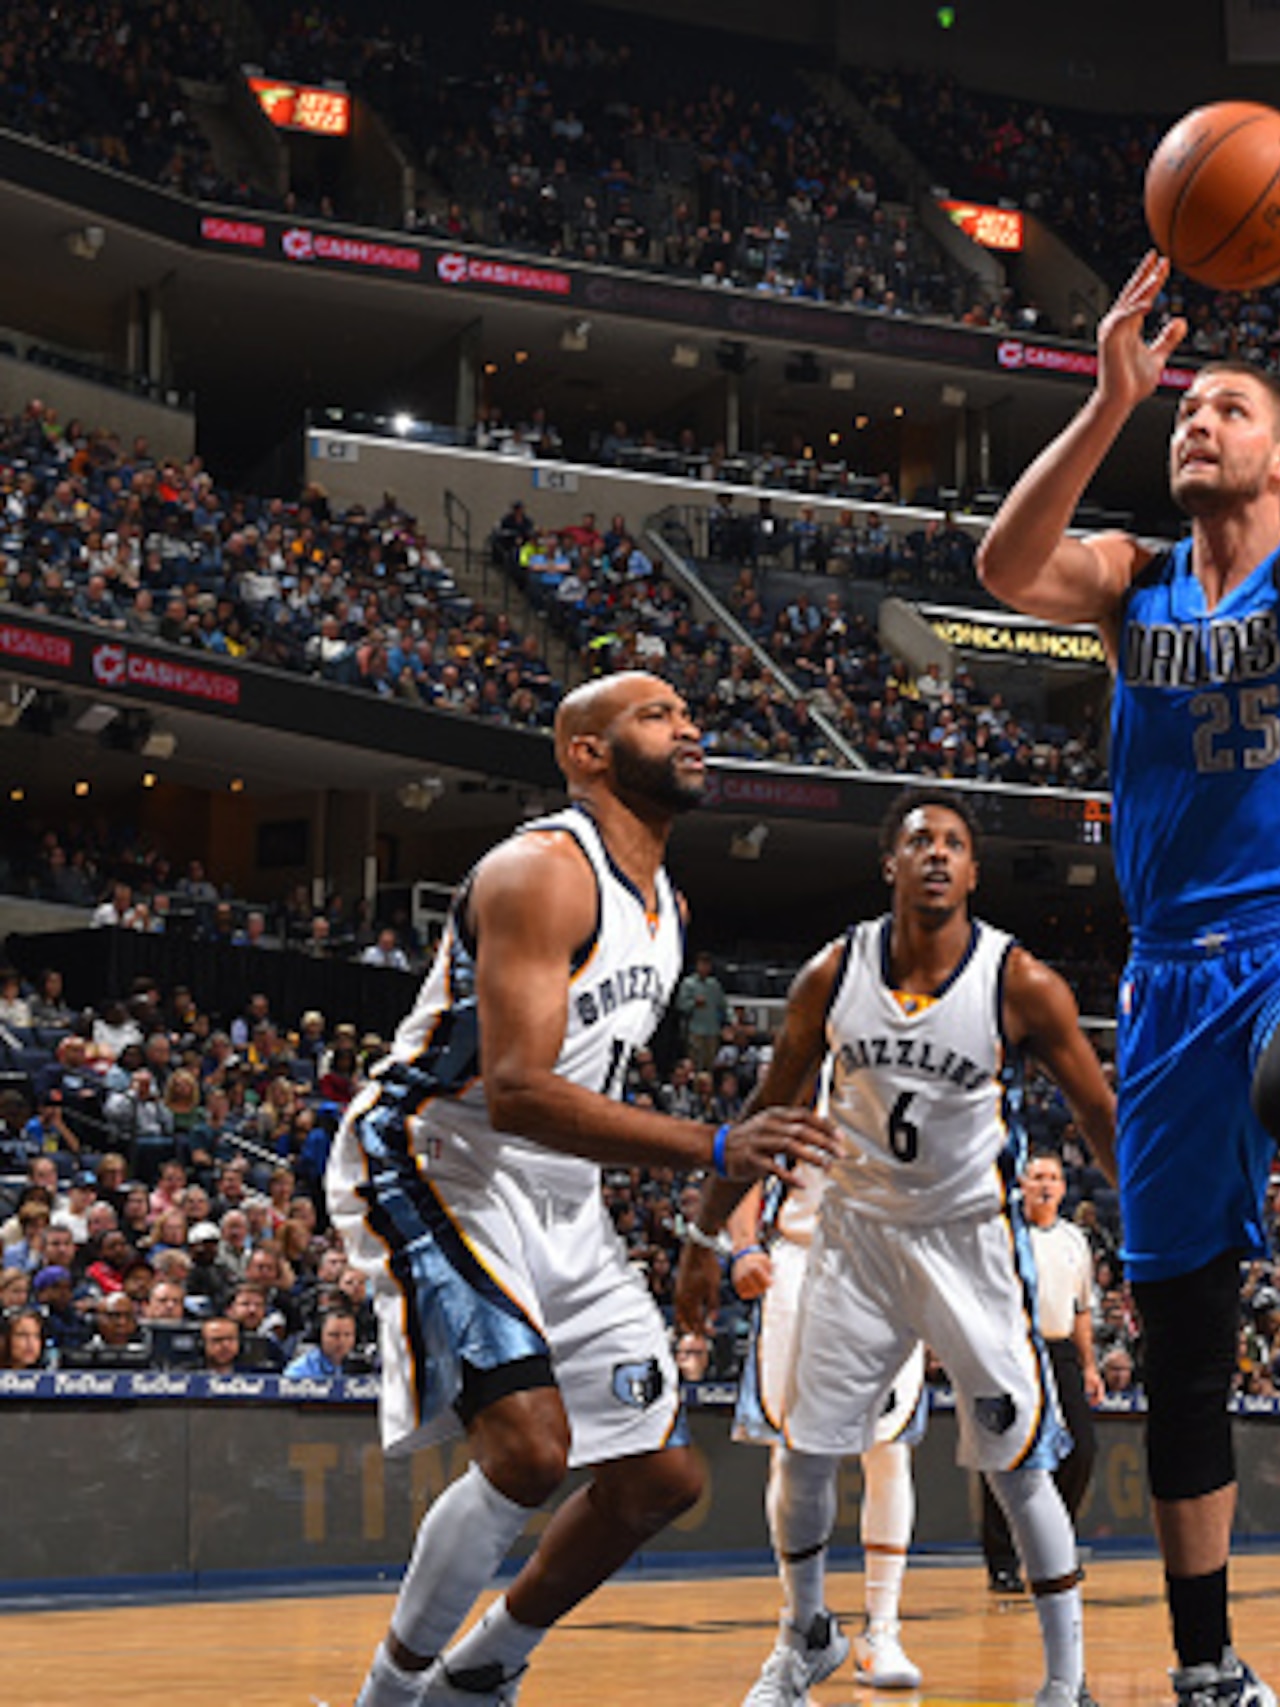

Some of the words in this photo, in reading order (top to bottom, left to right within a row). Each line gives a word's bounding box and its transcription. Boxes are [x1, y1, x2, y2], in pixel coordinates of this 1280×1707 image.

[128, 654, 239, 702] CASHSAVER
[841, 1036, 992, 1091] RIZZLIES
[889, 1091, 918, 1163] 6
